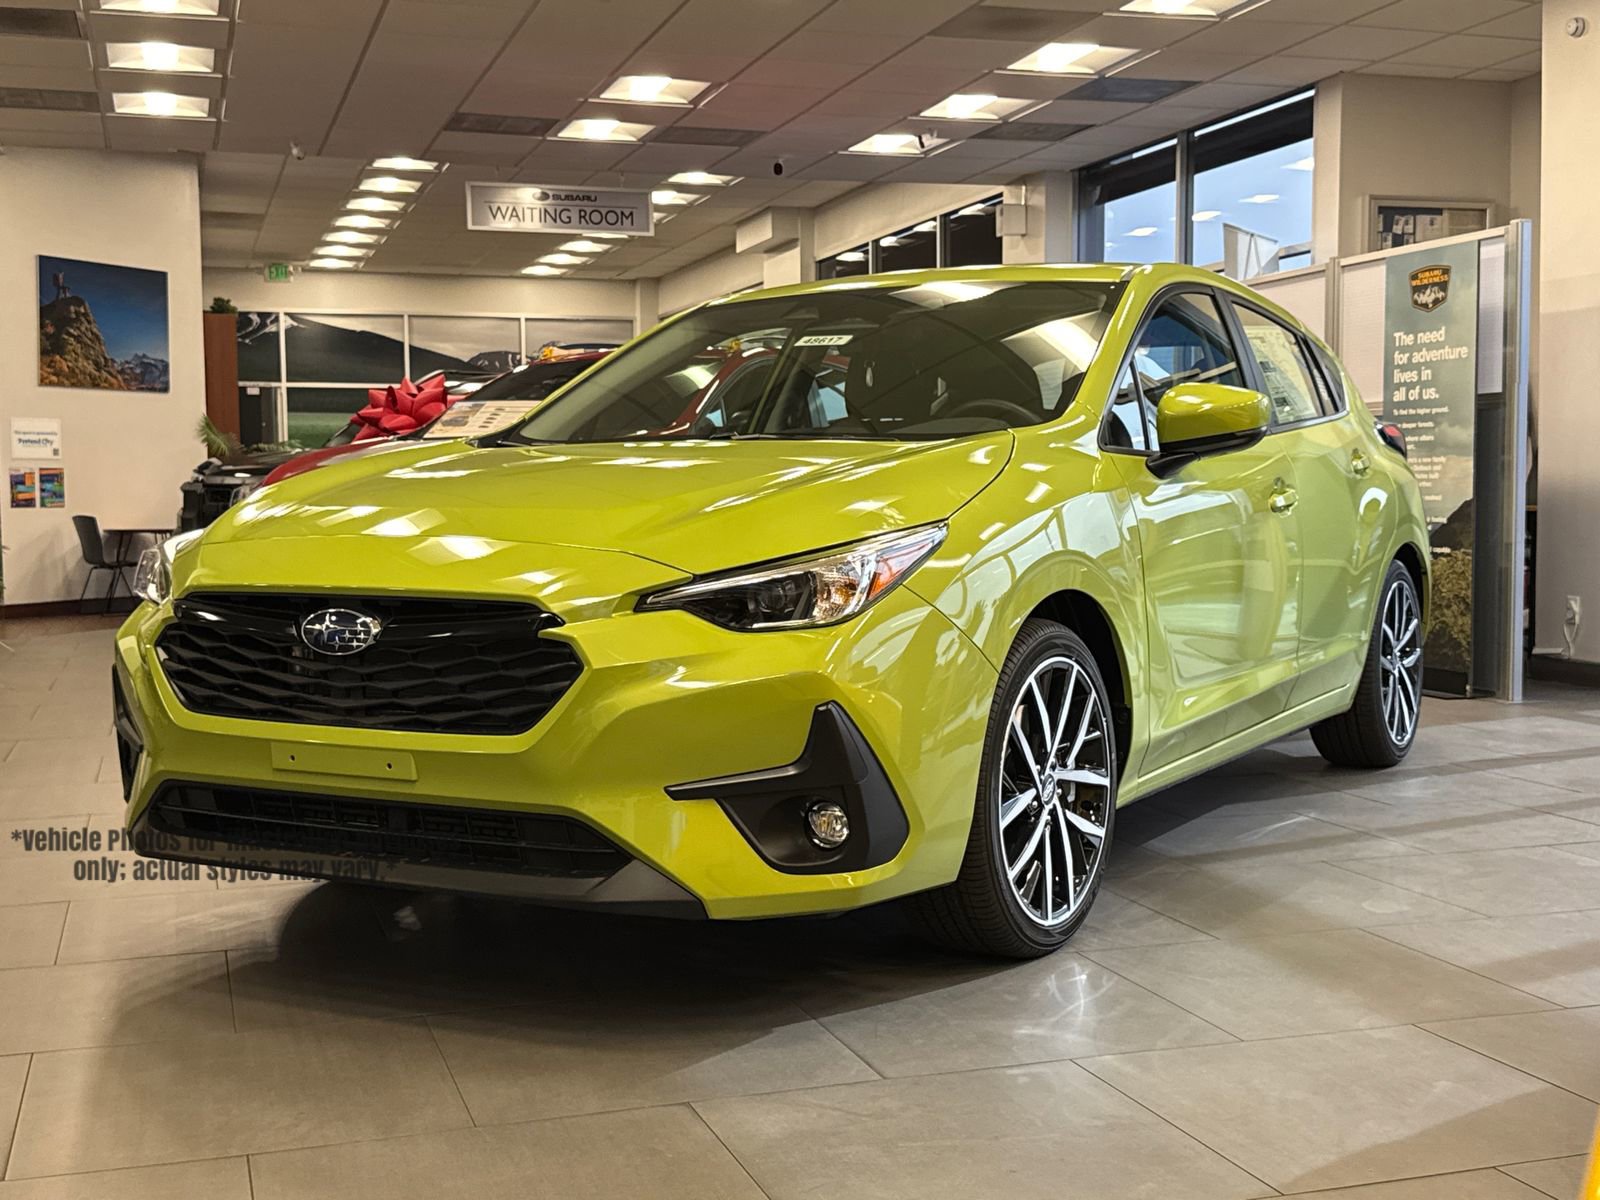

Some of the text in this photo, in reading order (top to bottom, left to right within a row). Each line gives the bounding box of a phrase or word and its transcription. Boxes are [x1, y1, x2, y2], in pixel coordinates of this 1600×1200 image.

[552, 193, 597, 202] SUBARU
[489, 205, 634, 226] WAITING ROOM
[1393, 326, 1446, 347] The need
[1394, 345, 1468, 366] for adventure
[1394, 366, 1432, 384] lives in
[1393, 386, 1439, 402] all of us.
